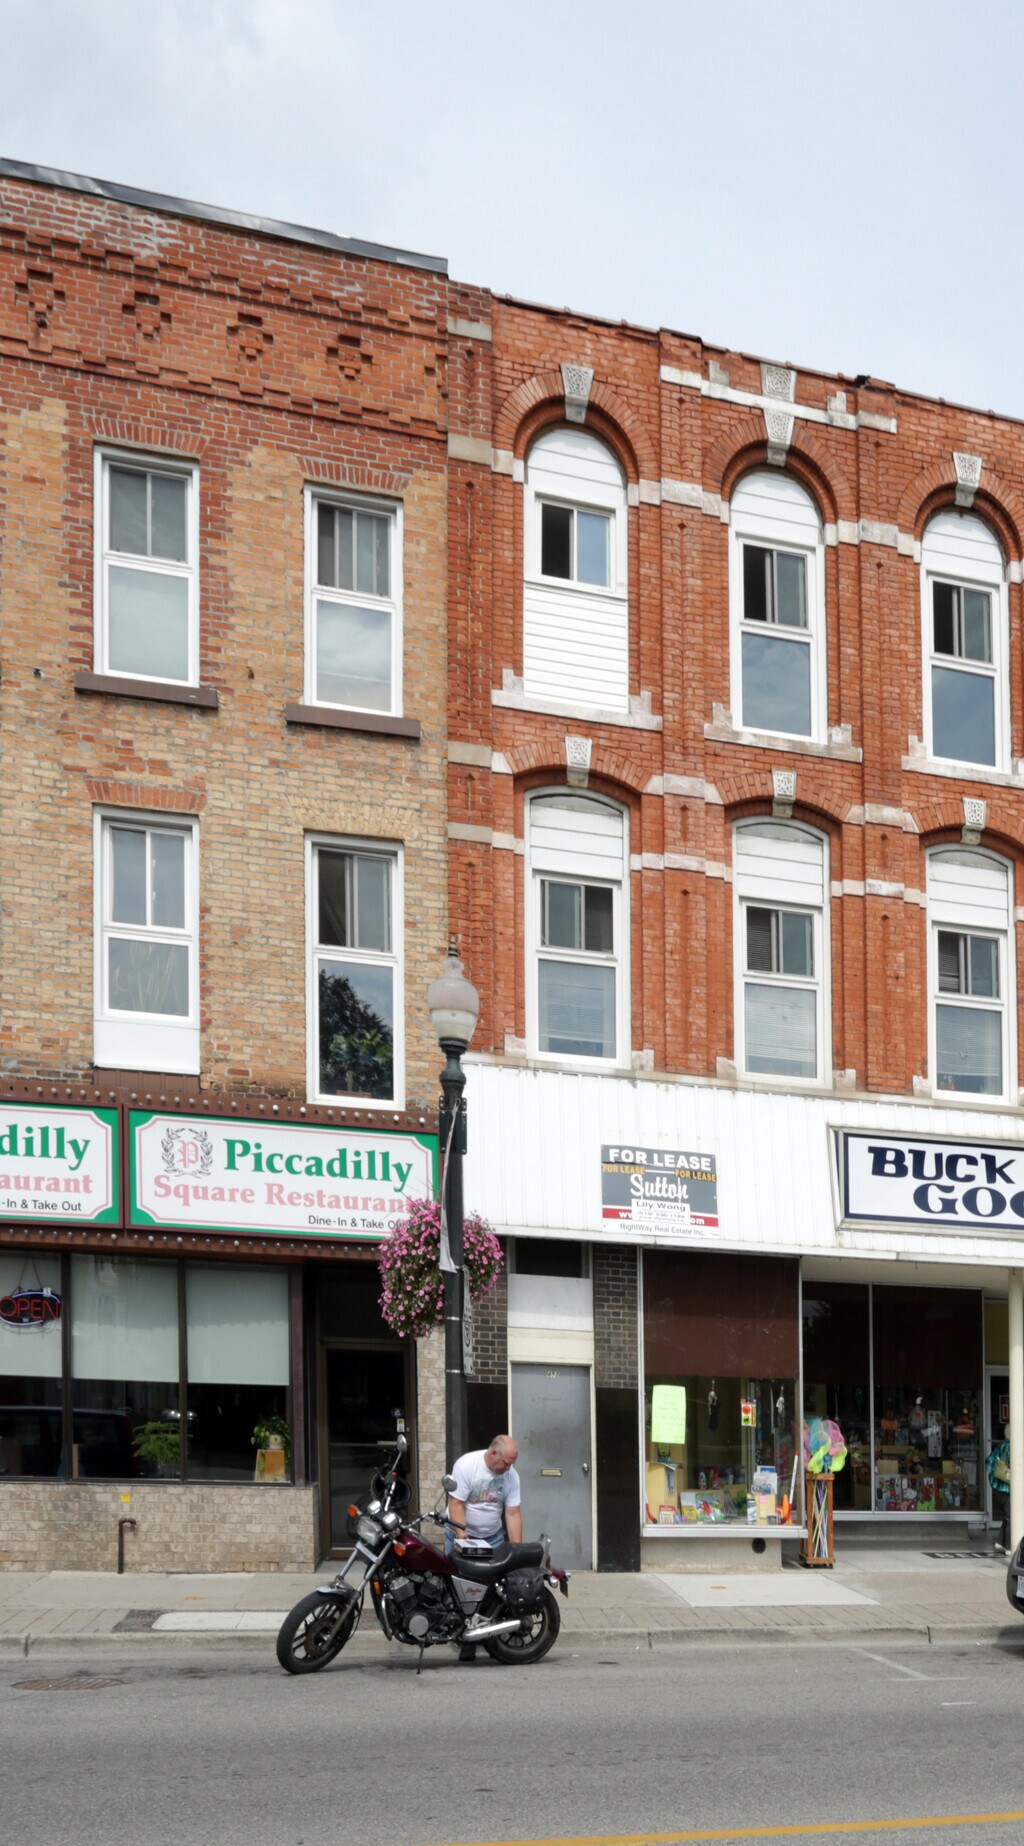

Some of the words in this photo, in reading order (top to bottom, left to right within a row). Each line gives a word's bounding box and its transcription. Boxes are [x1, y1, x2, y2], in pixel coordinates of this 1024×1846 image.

[223, 1138, 413, 1192] Piccadilly
[608, 1148, 648, 1164] FOR
[653, 1153, 711, 1171] LEASE
[868, 1146, 1016, 1184] BUCK
[602, 1164, 619, 1173] FOR
[620, 1165, 646, 1175] LEASE
[675, 1169, 691, 1178] FOR
[692, 1172, 716, 1182] LEASE
[154, 1175, 255, 1207] Square
[630, 1173, 689, 1200] Sutton
[20, 1199, 28, 1209] &
[32, 1200, 58, 1211] Take
[62, 1201, 82, 1211] Out
[636, 1201, 653, 1210] Lily
[657, 1202, 686, 1212] Wong
[350, 1218, 358, 1228] &
[360, 1218, 384, 1229] Take
[620, 1223, 653, 1232] RightWay
[0, 1296, 60, 1320] OPEN
